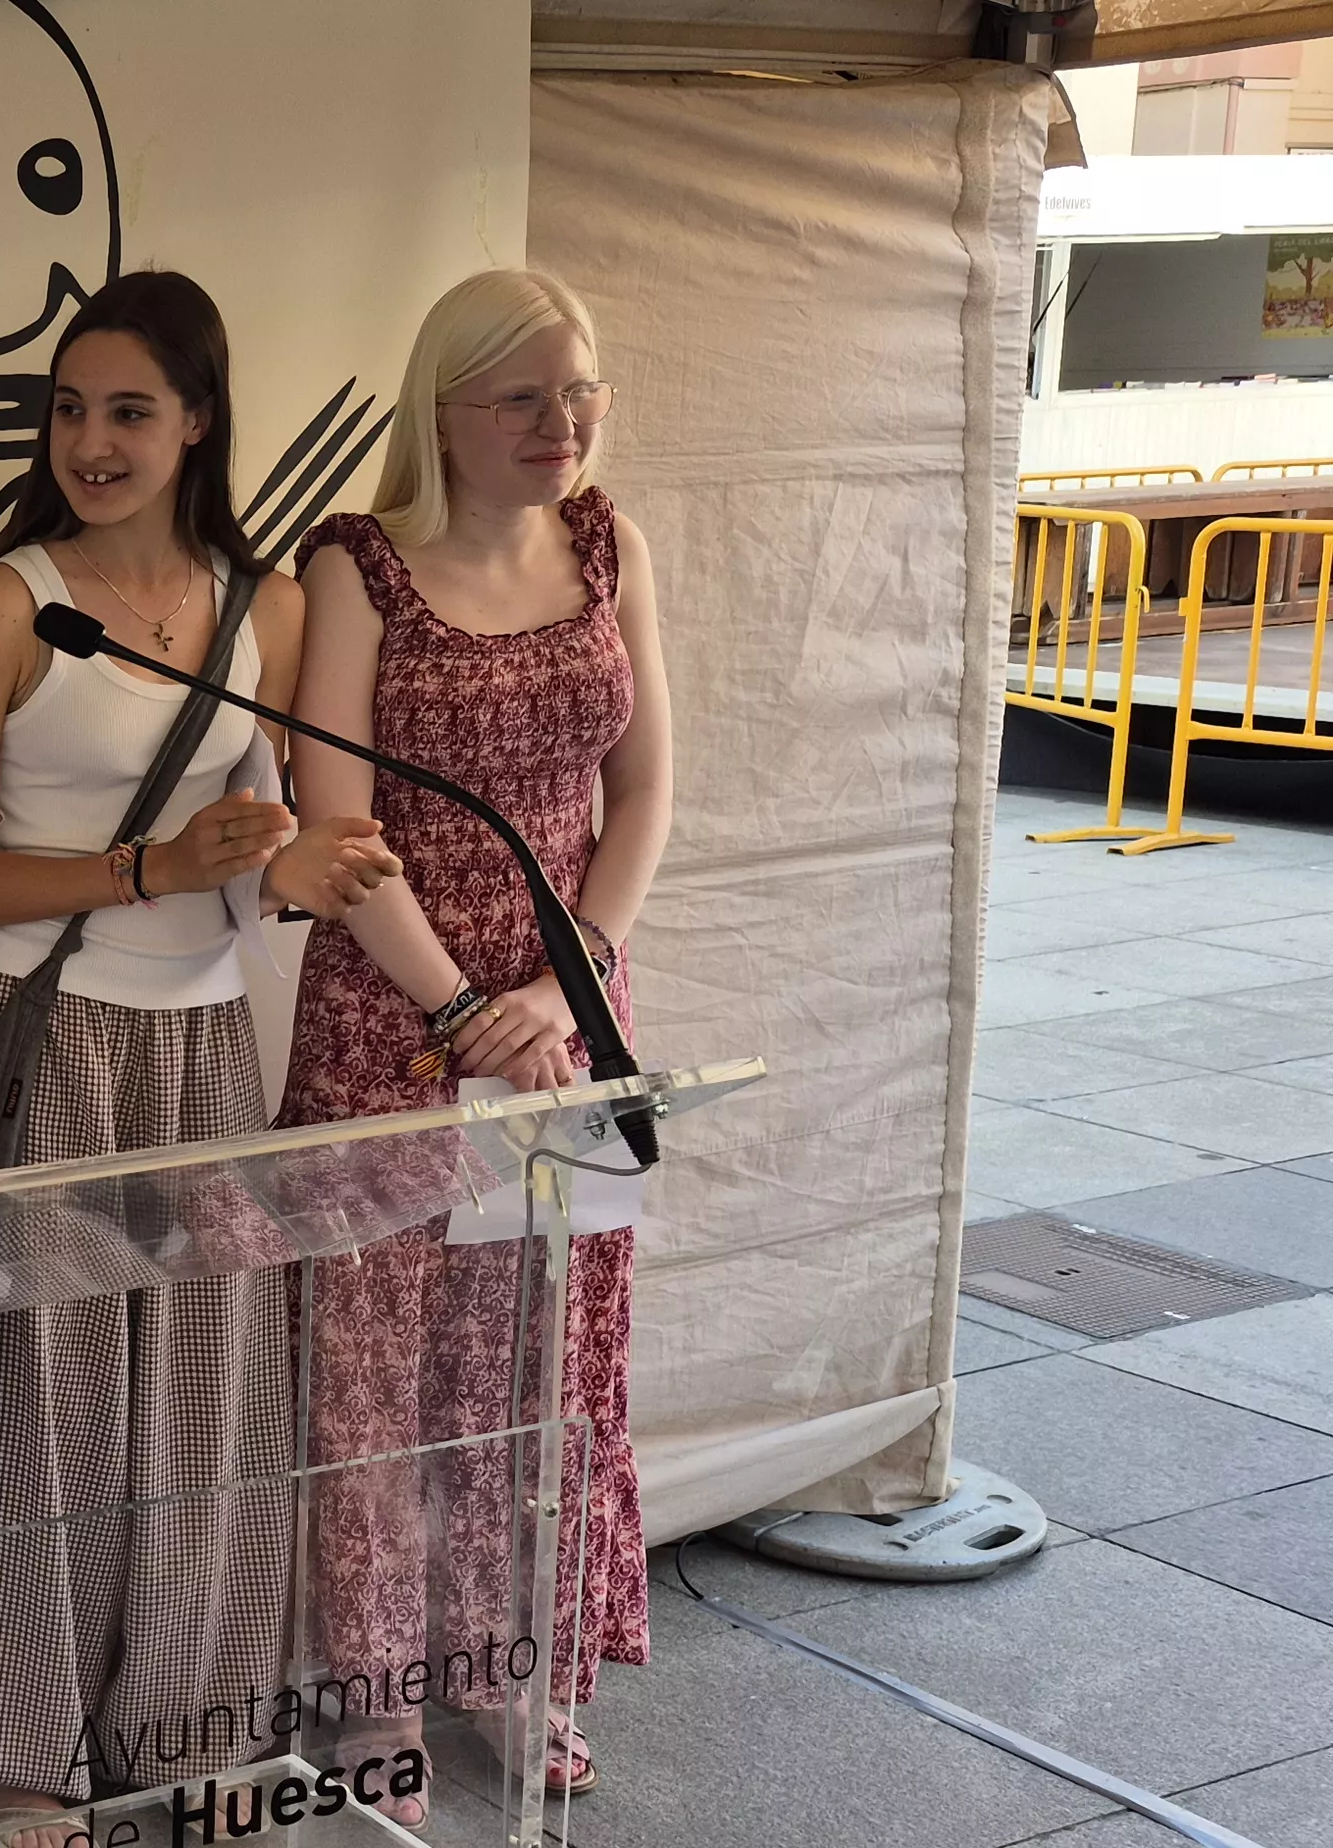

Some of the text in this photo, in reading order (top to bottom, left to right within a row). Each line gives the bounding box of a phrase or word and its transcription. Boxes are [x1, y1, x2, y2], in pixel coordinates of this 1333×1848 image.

[1045, 196, 1092, 210] Edelvives
[64, 1631, 539, 1793] Ayuntamiento
[62, 1745, 425, 1848] de Huesca
